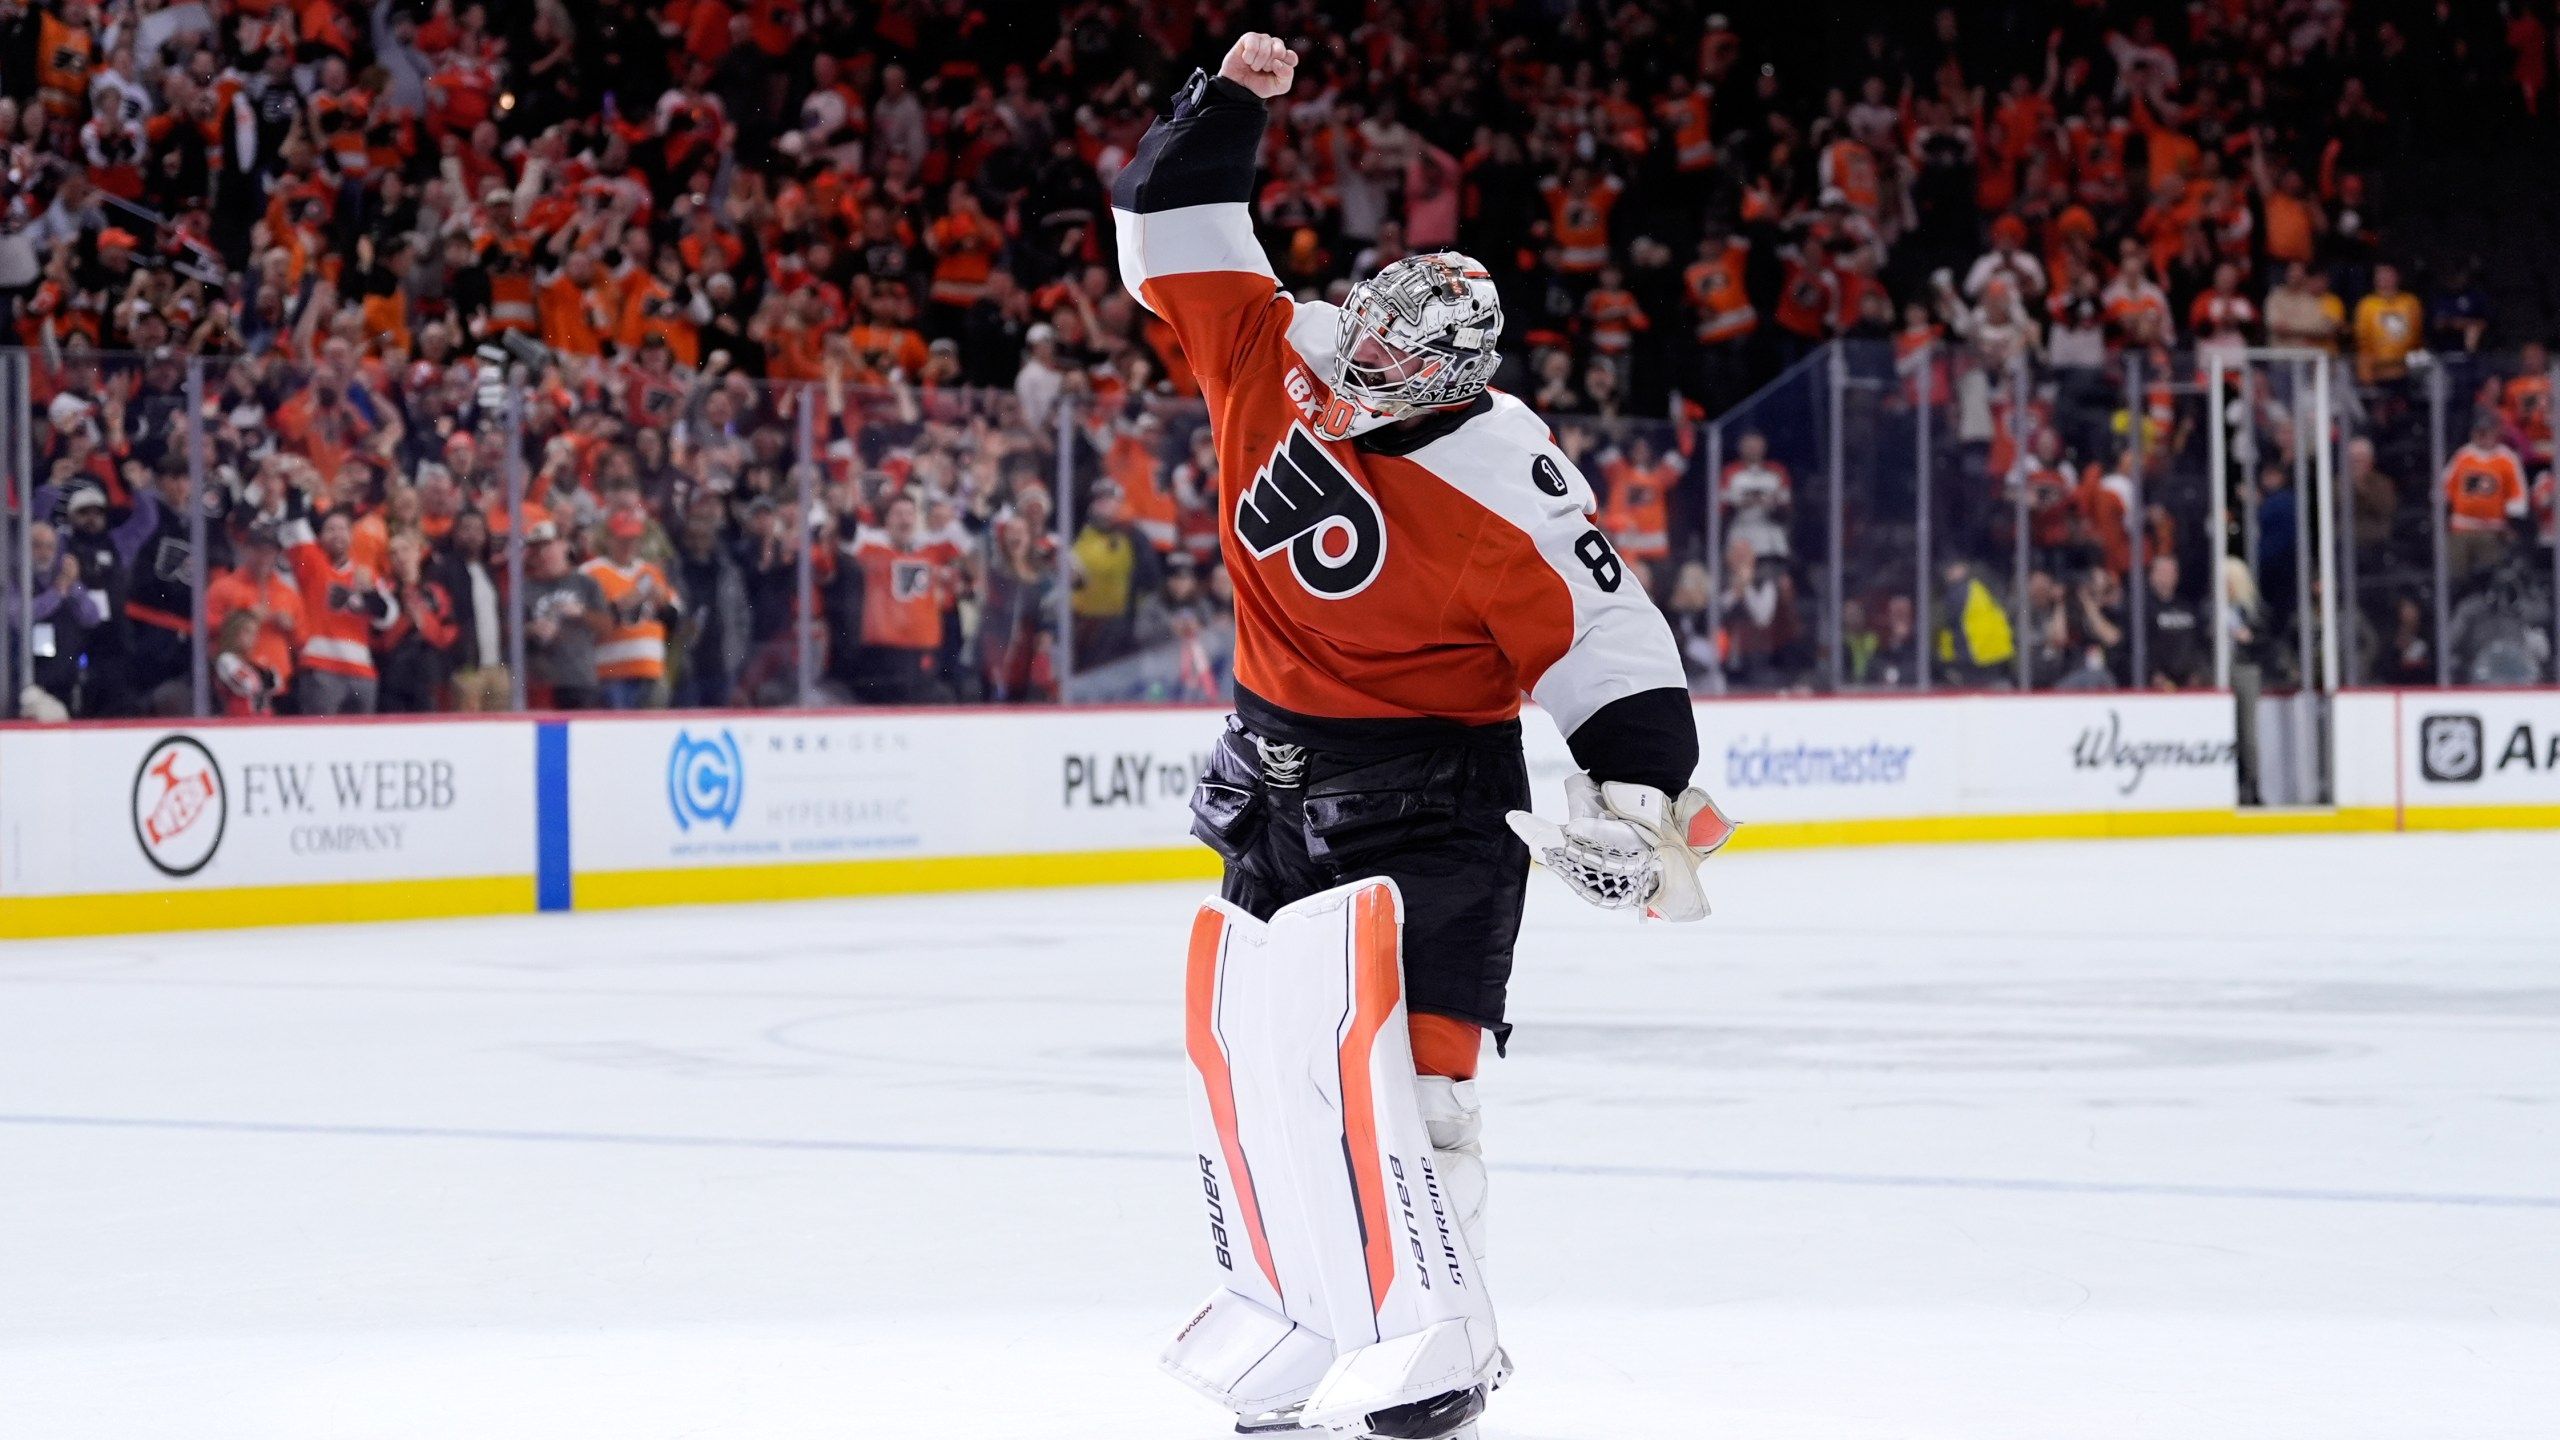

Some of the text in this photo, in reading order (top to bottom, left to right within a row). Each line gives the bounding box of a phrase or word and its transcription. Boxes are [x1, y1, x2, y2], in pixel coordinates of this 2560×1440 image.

[1284, 367, 1324, 420] IBX
[1420, 377, 1488, 402] YERS
[1540, 459, 1565, 491] 1
[1726, 735, 1914, 787] ticketmaster
[2073, 709, 2236, 795] Wegman
[330, 760, 455, 811] WEBB
[1064, 754, 1153, 807] PLAY
[290, 824, 404, 854] COMPANY
[1198, 1153, 1233, 1272] BAUER
[1389, 1154, 1431, 1291] BAUER
[1420, 1156, 1468, 1291] SUPREME
[1176, 1303, 1213, 1343] SHADOW
